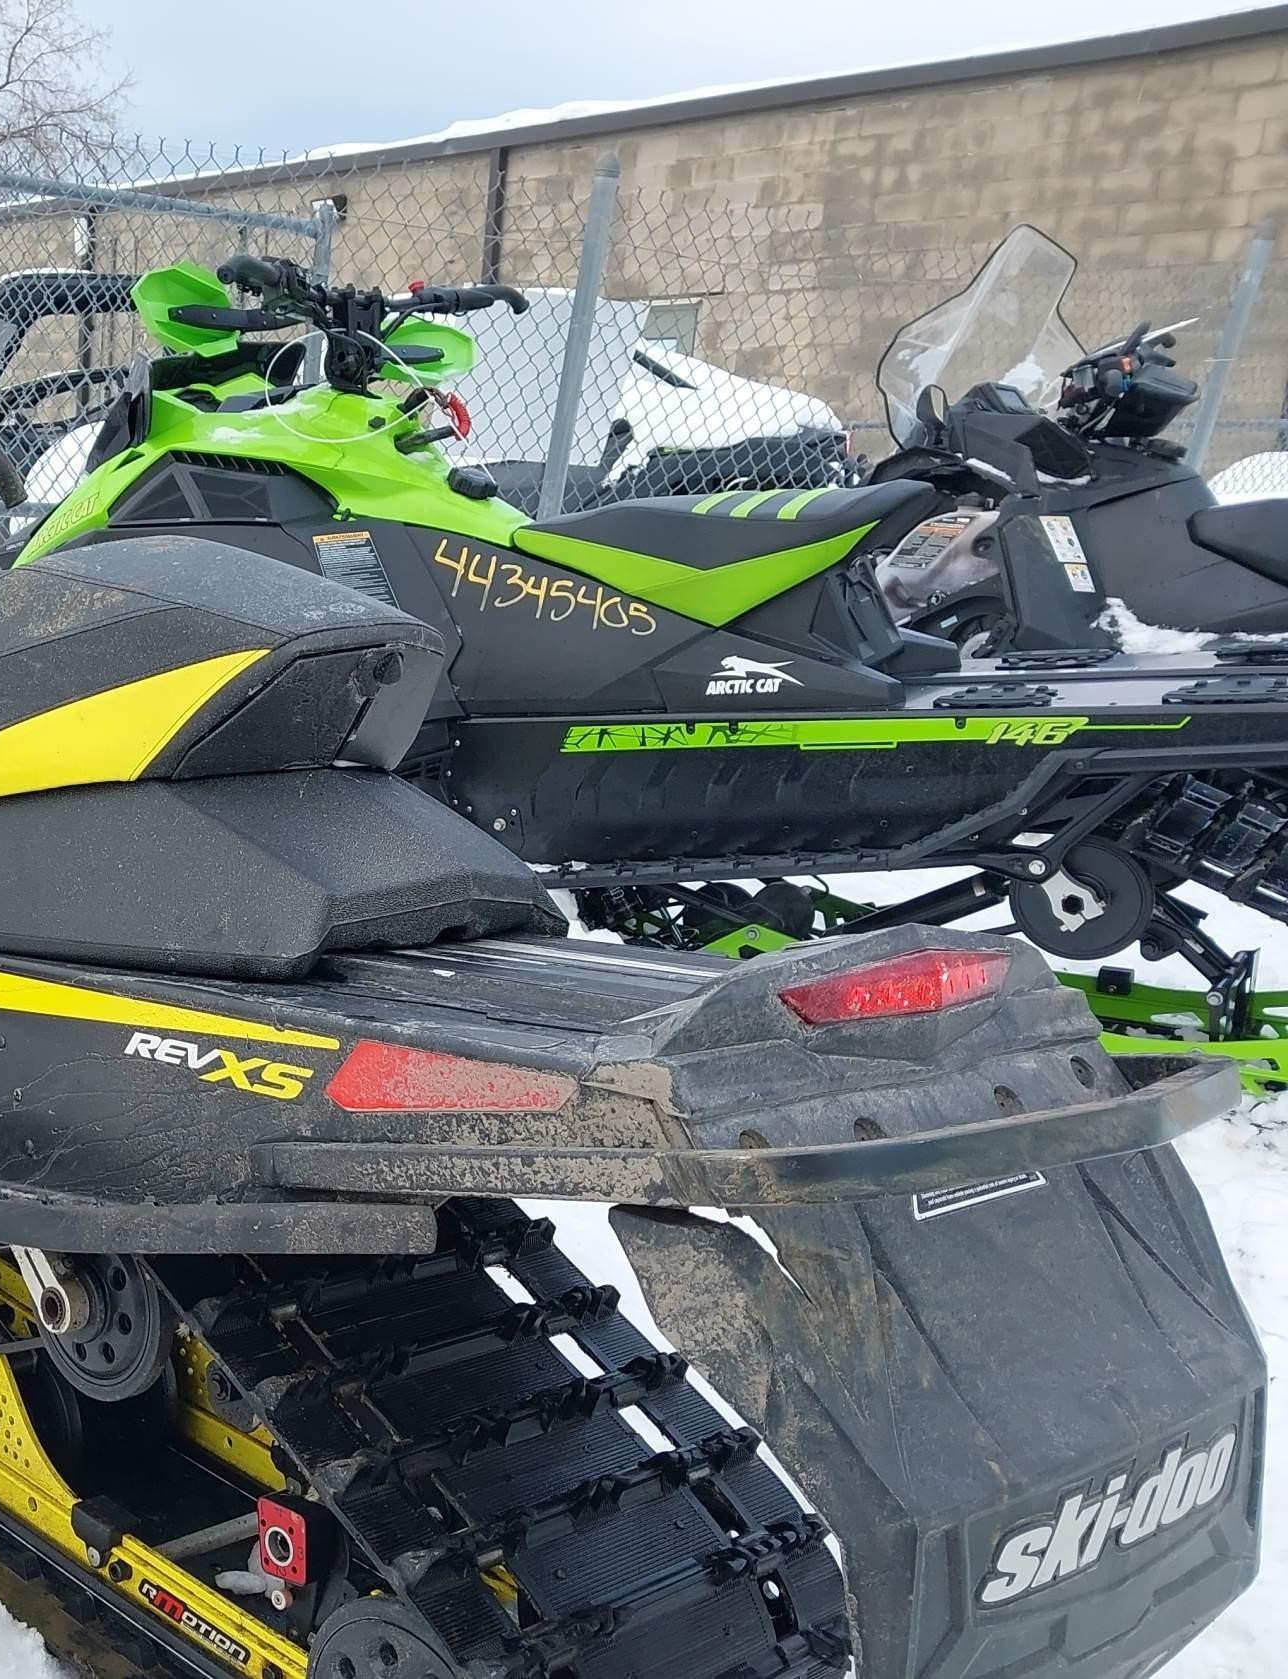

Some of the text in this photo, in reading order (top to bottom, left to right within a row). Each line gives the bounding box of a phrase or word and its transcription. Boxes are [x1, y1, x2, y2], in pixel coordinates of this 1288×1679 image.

[72, 491, 100, 524] CAT
[434, 538, 657, 636] 44345405
[705, 678, 783, 696] ARCTIC CAT
[985, 722, 1073, 747] 146
